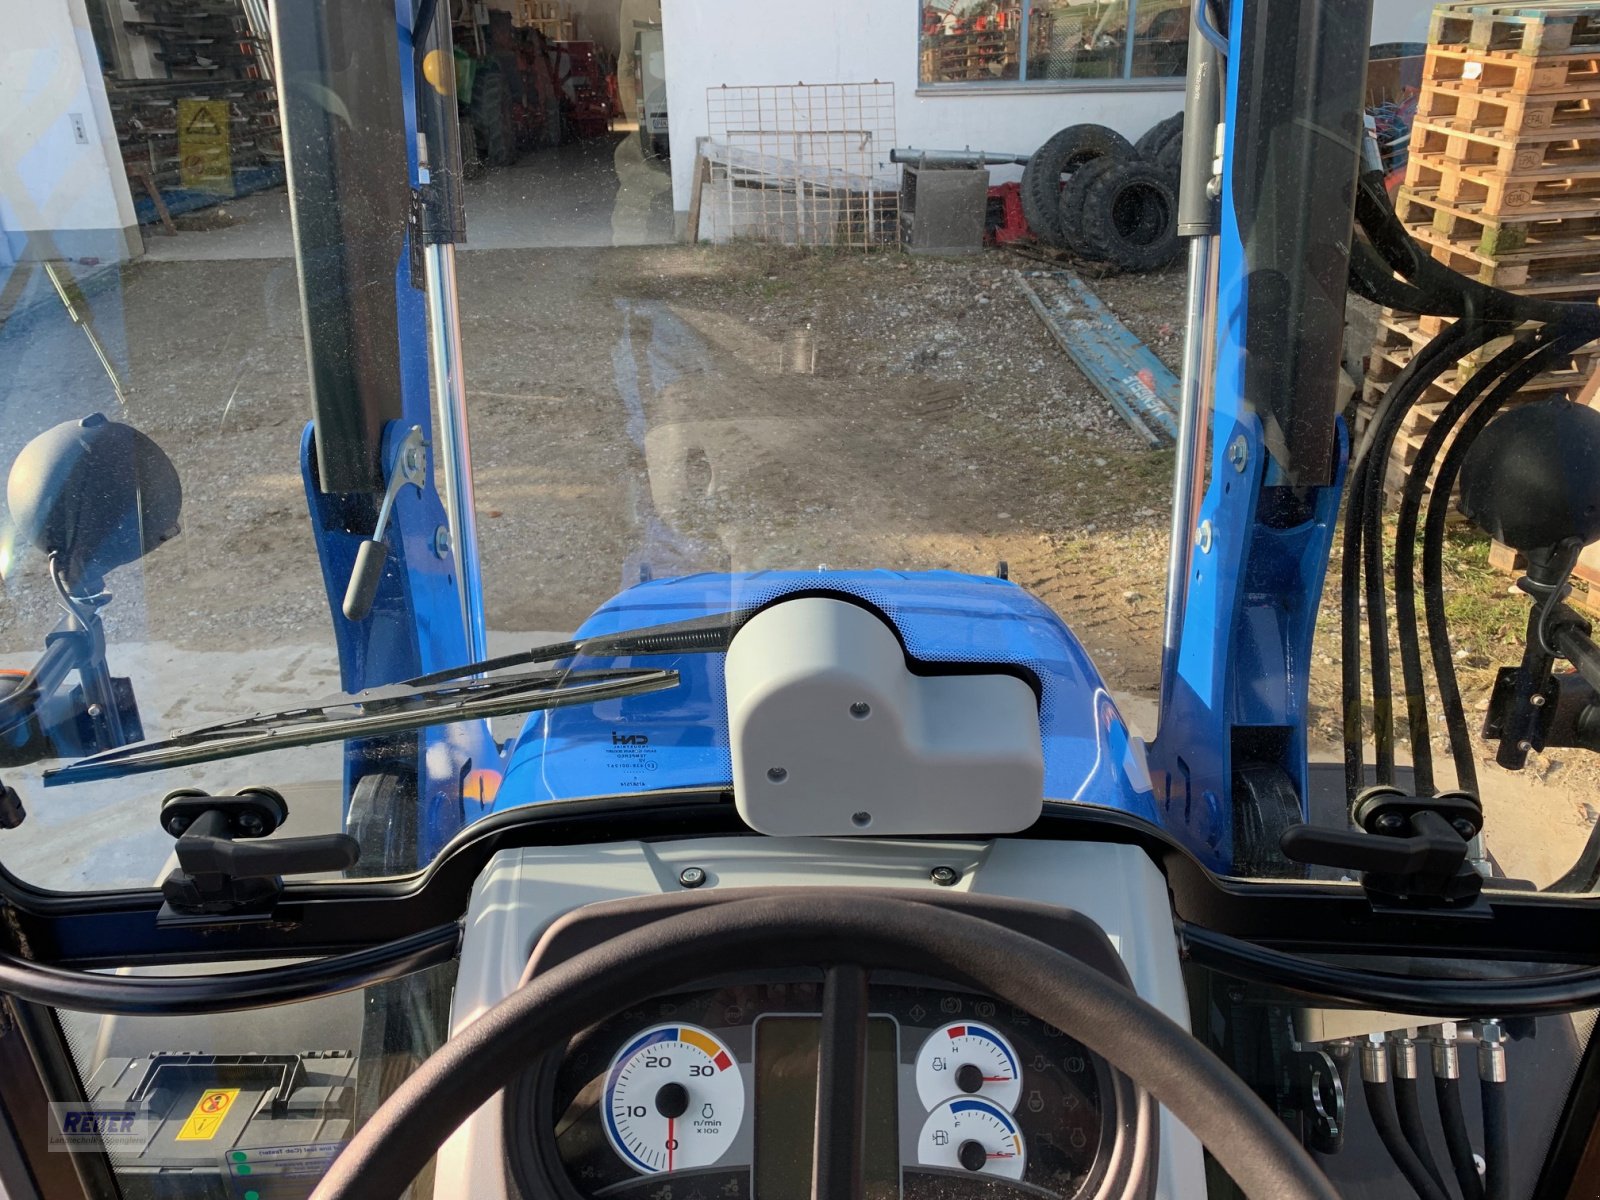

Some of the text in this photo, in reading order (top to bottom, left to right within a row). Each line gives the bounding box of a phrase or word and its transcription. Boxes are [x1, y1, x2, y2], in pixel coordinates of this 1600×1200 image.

[645, 1056, 672, 1068] 20
[689, 1065, 714, 1077] 30
[627, 1105, 647, 1117] 10
[693, 1119, 722, 1127] n/min
[665, 1139, 679, 1151] 0
